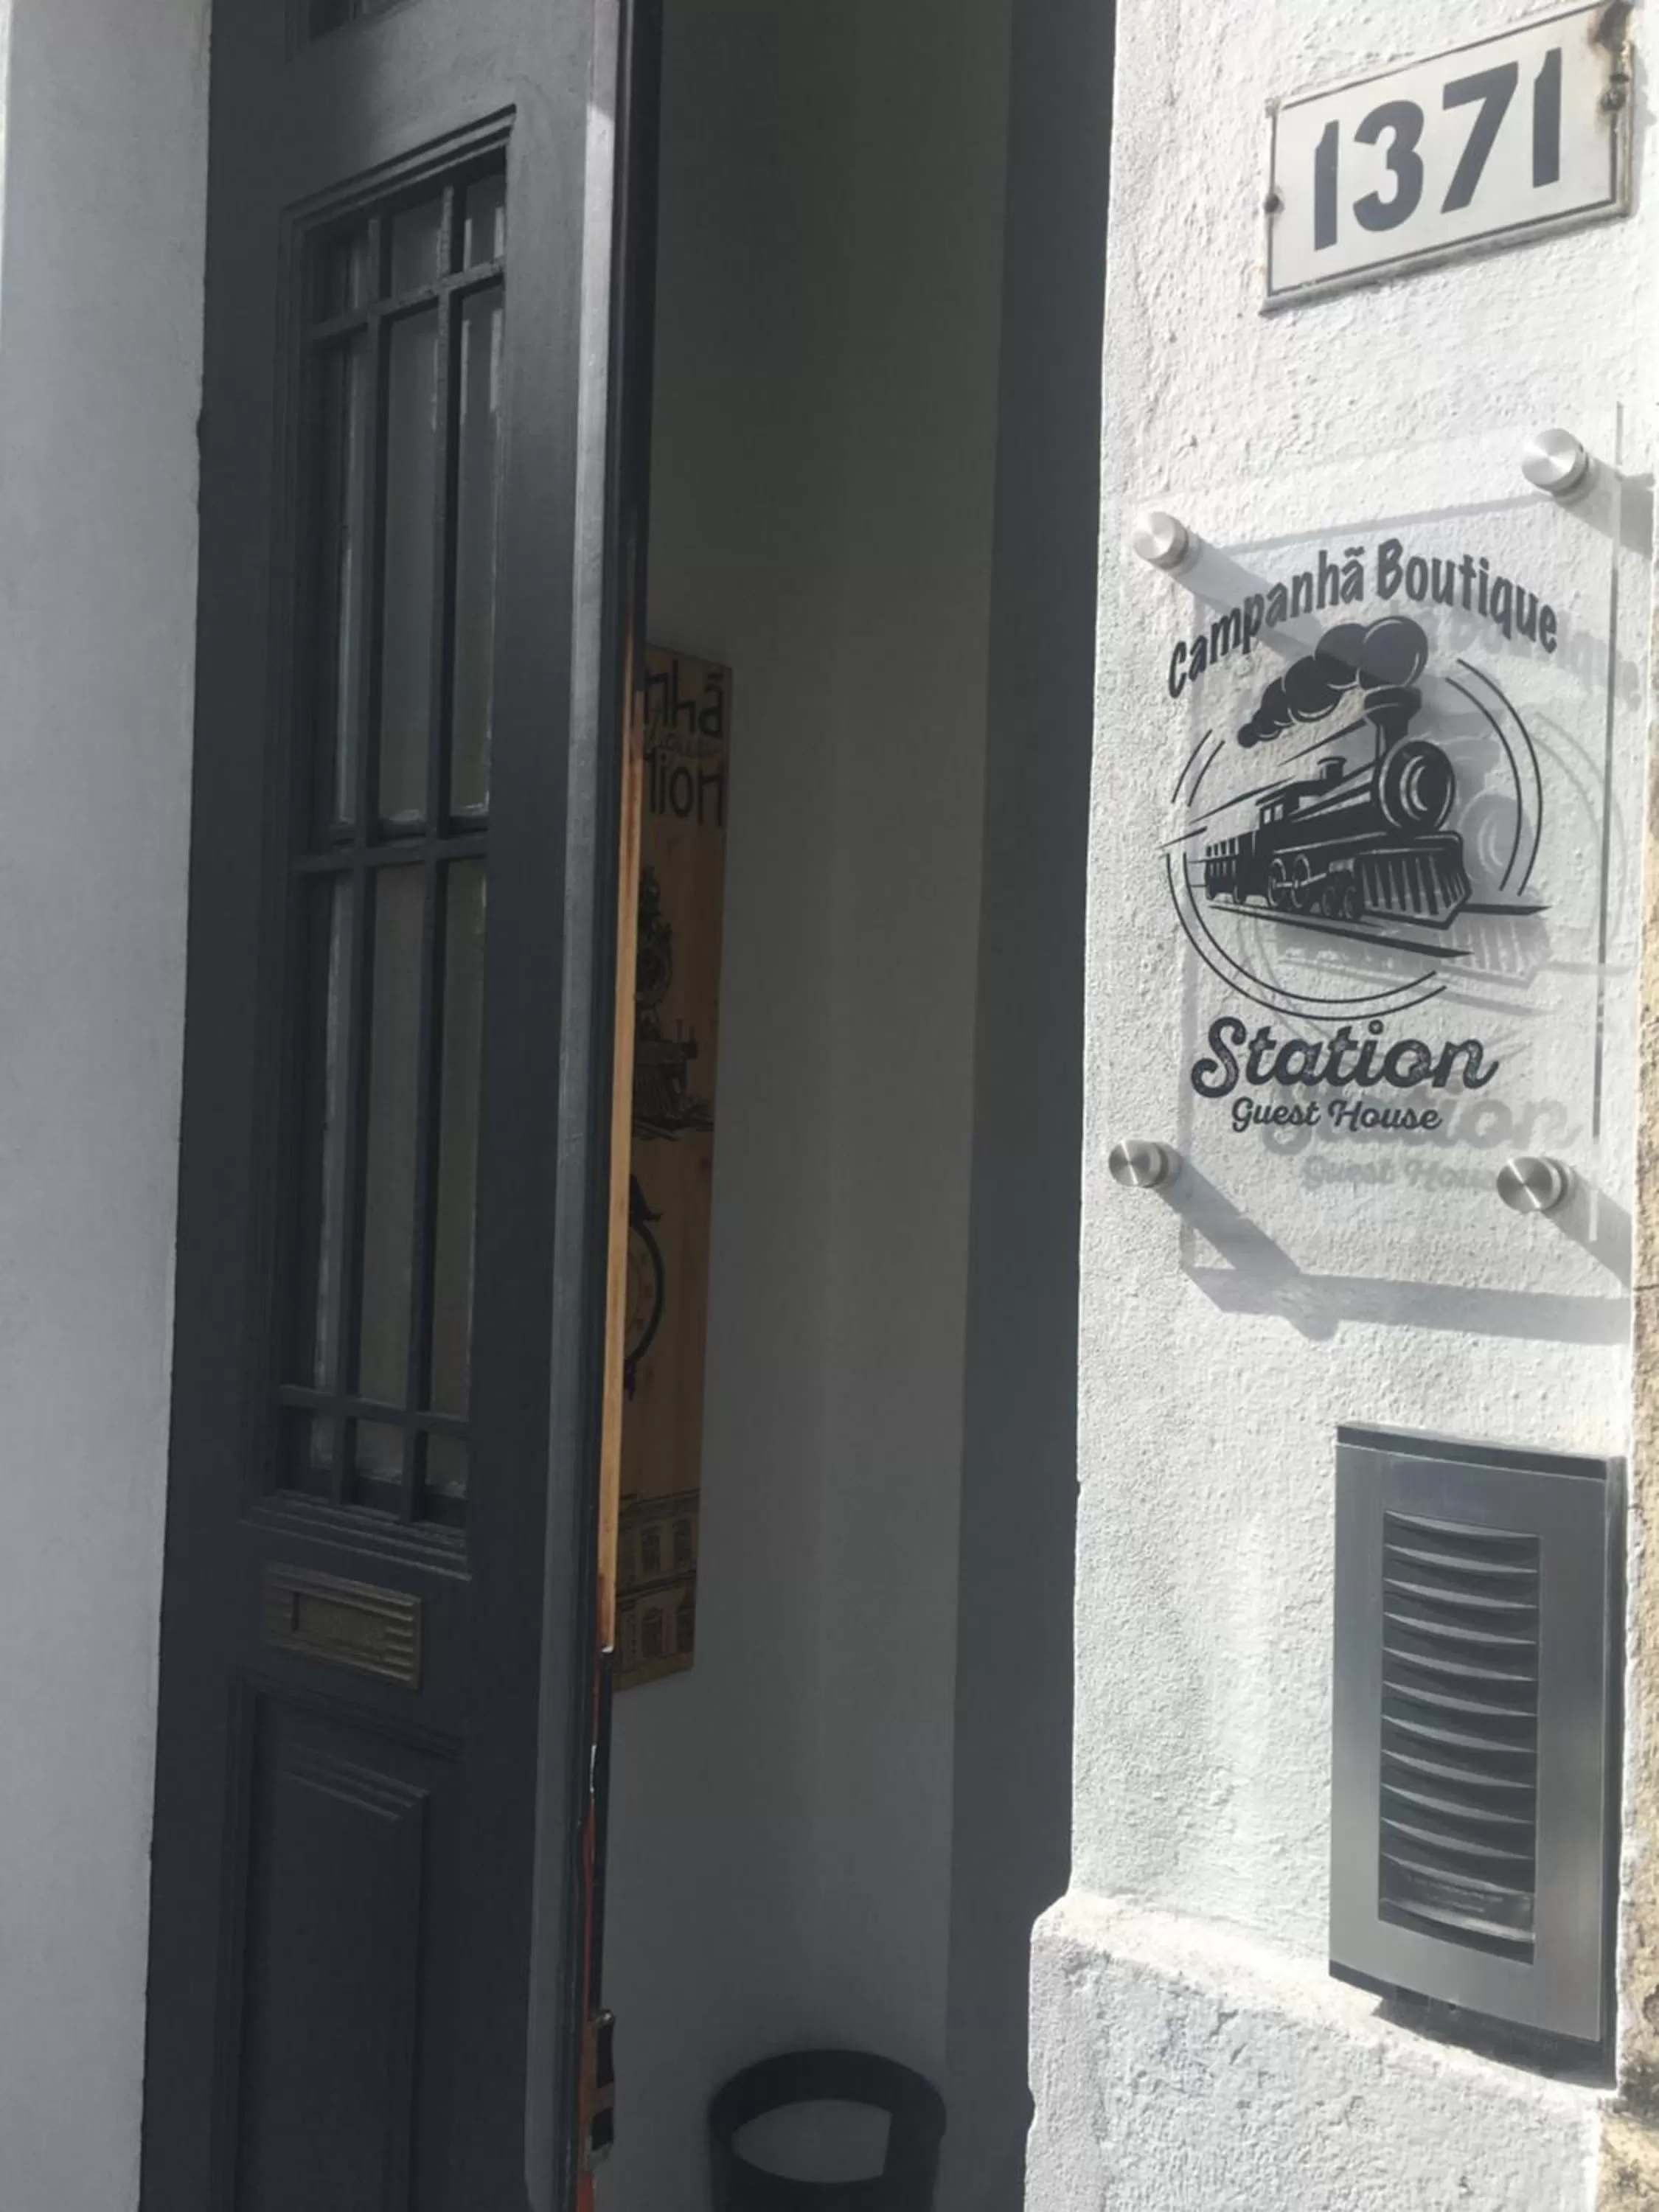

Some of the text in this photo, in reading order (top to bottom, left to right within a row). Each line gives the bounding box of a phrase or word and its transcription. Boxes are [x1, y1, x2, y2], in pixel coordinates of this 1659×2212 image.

[1314, 46, 1562, 251] 1371
[1167, 538, 1557, 699] Campanhã Boutique
[1191, 1016, 1500, 1099] Station
[1231, 1096, 1443, 1133] Guest House
